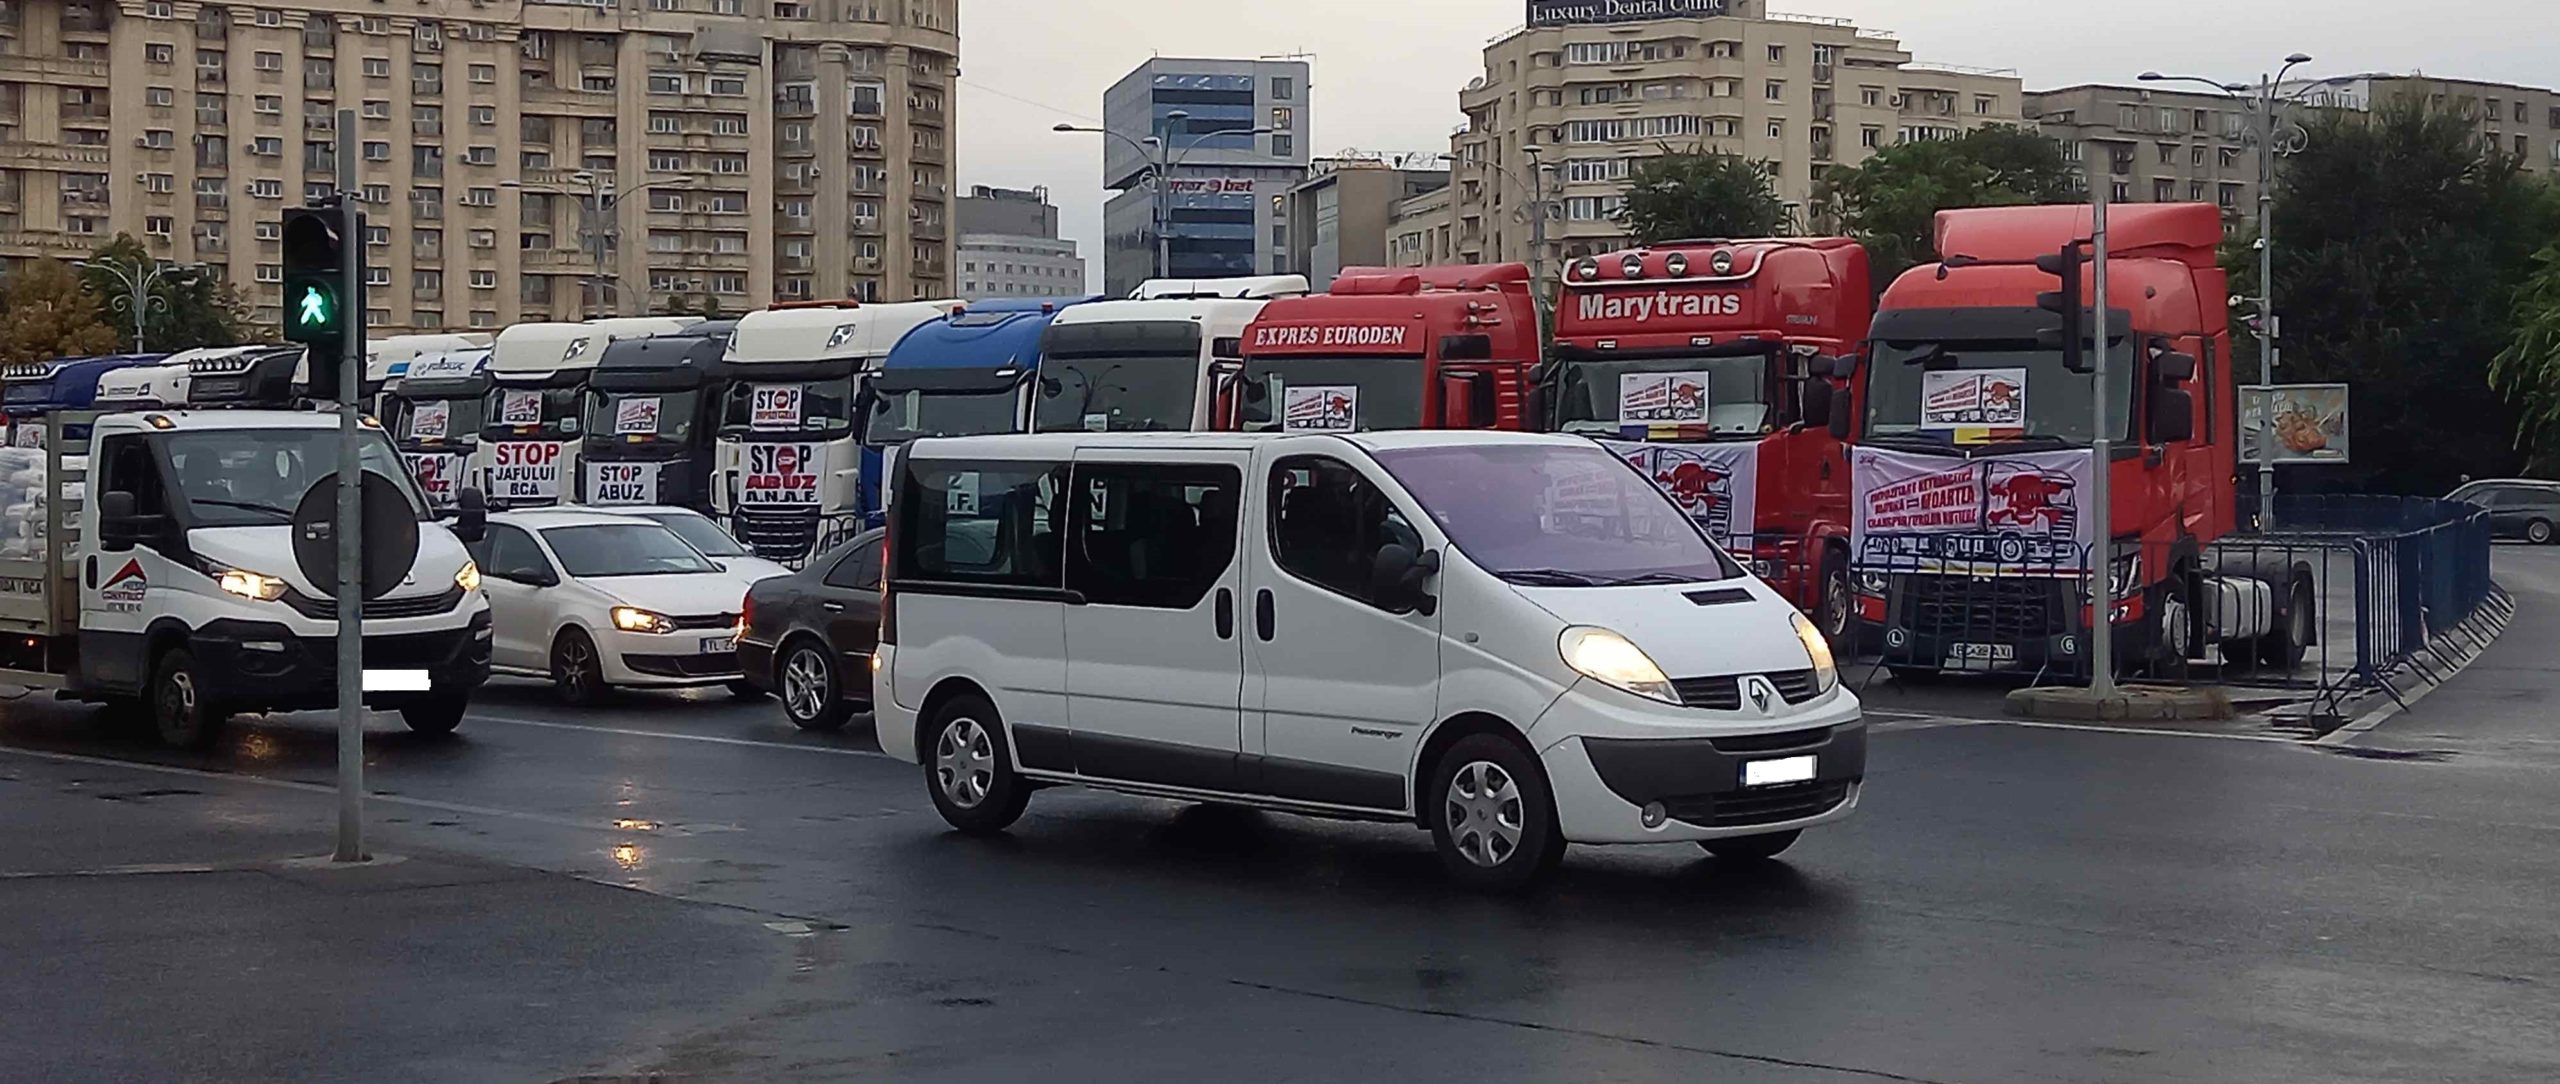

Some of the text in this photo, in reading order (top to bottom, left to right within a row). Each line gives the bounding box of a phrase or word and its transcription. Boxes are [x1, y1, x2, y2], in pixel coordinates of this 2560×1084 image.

[1532, 4, 1599, 22] Luxury
[1605, 0, 1664, 16] Dental
[1579, 291, 1740, 322] Marytrans
[1255, 326, 1406, 346] EXPRES EURODEN
[756, 390, 799, 409] STOP
[496, 443, 560, 465] STOP
[750, 445, 811, 475] STOP
[496, 467, 555, 481] JAFULUI
[600, 466, 641, 482] STOP
[745, 475, 817, 489] ABUZ
[598, 484, 645, 500] ABUZ
